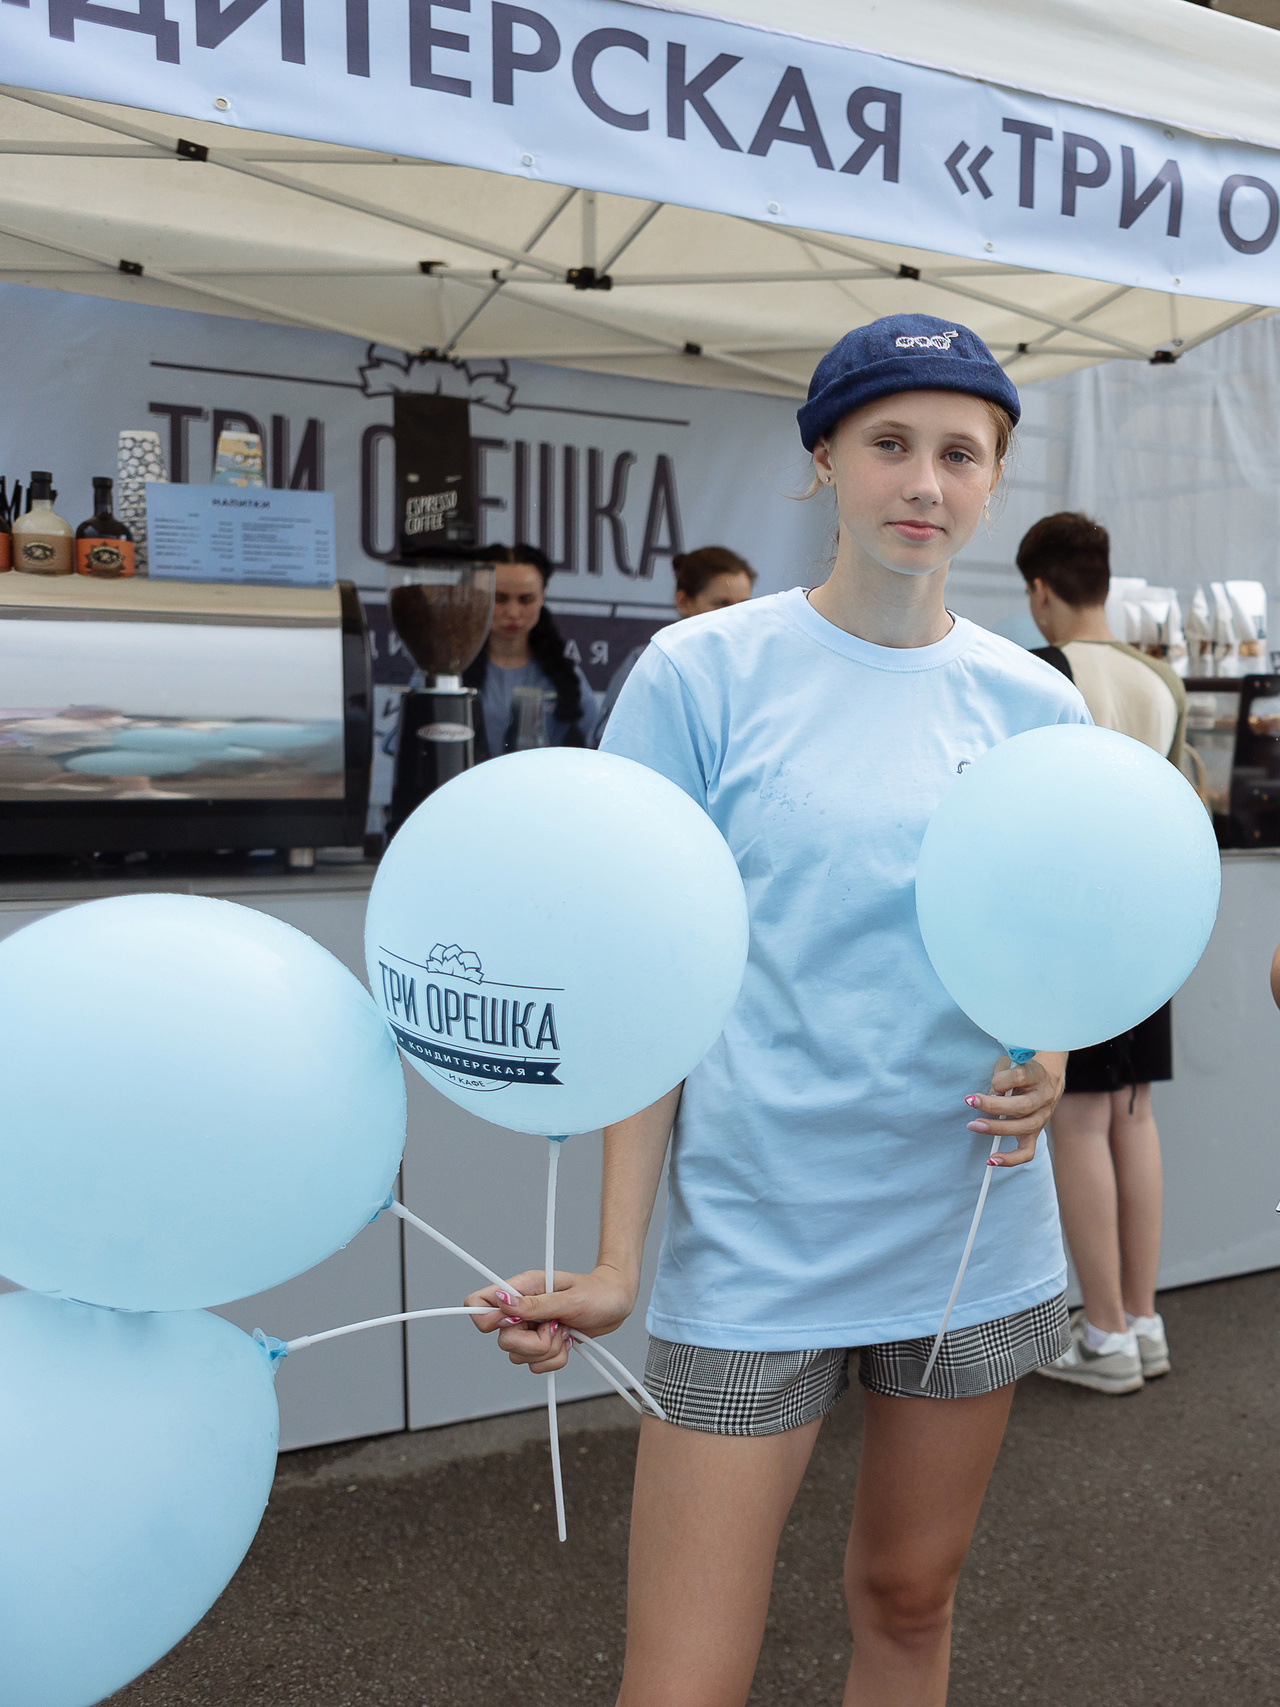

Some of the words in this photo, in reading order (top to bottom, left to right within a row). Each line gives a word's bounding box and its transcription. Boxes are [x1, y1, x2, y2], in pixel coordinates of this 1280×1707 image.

[944, 117, 1183, 238] «ТРИ
[361, 423, 690, 580] ОЕШКА
[406, 490, 458, 514] ESPRESSO
[405, 512, 445, 536] COFFEE
[378, 960, 420, 1028] ТРИ
[426, 983, 561, 1051] ОРЕШКА
[408, 1040, 526, 1076] КОНДИТЕРСКАЯ
[449, 1073, 456, 1081] И
[458, 1077, 485, 1088] КАФЕ
